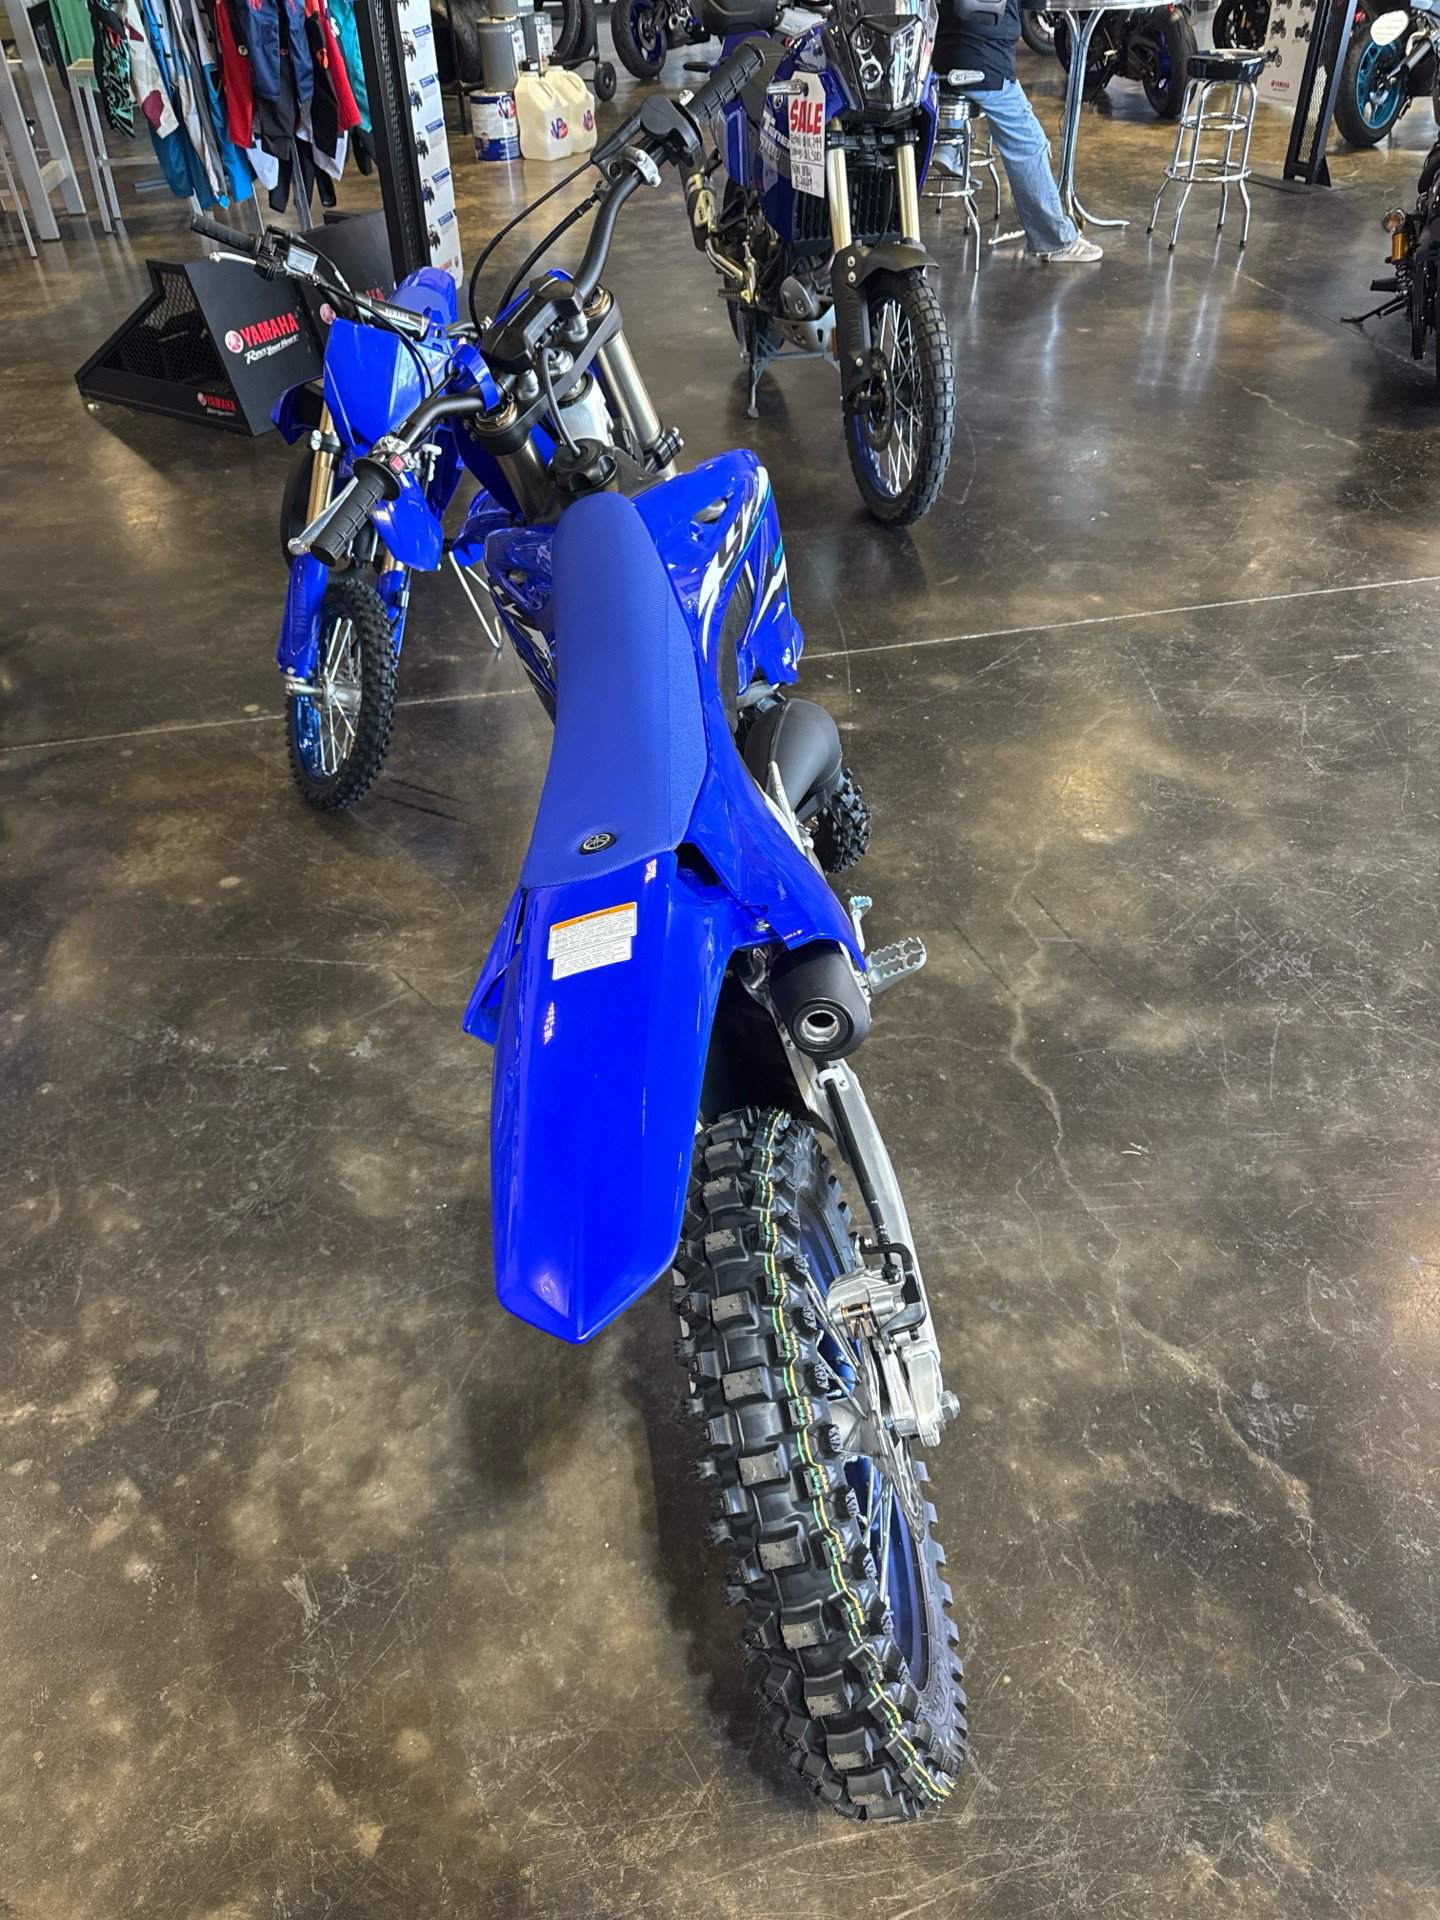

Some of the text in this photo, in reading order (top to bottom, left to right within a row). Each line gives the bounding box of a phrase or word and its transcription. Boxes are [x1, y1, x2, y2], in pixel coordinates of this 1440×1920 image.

[551, 117, 565, 139] VP
[790, 99, 823, 136] SALE
[385, 307, 410, 322] YAMAHA
[239, 312, 300, 348] YAMAHA
